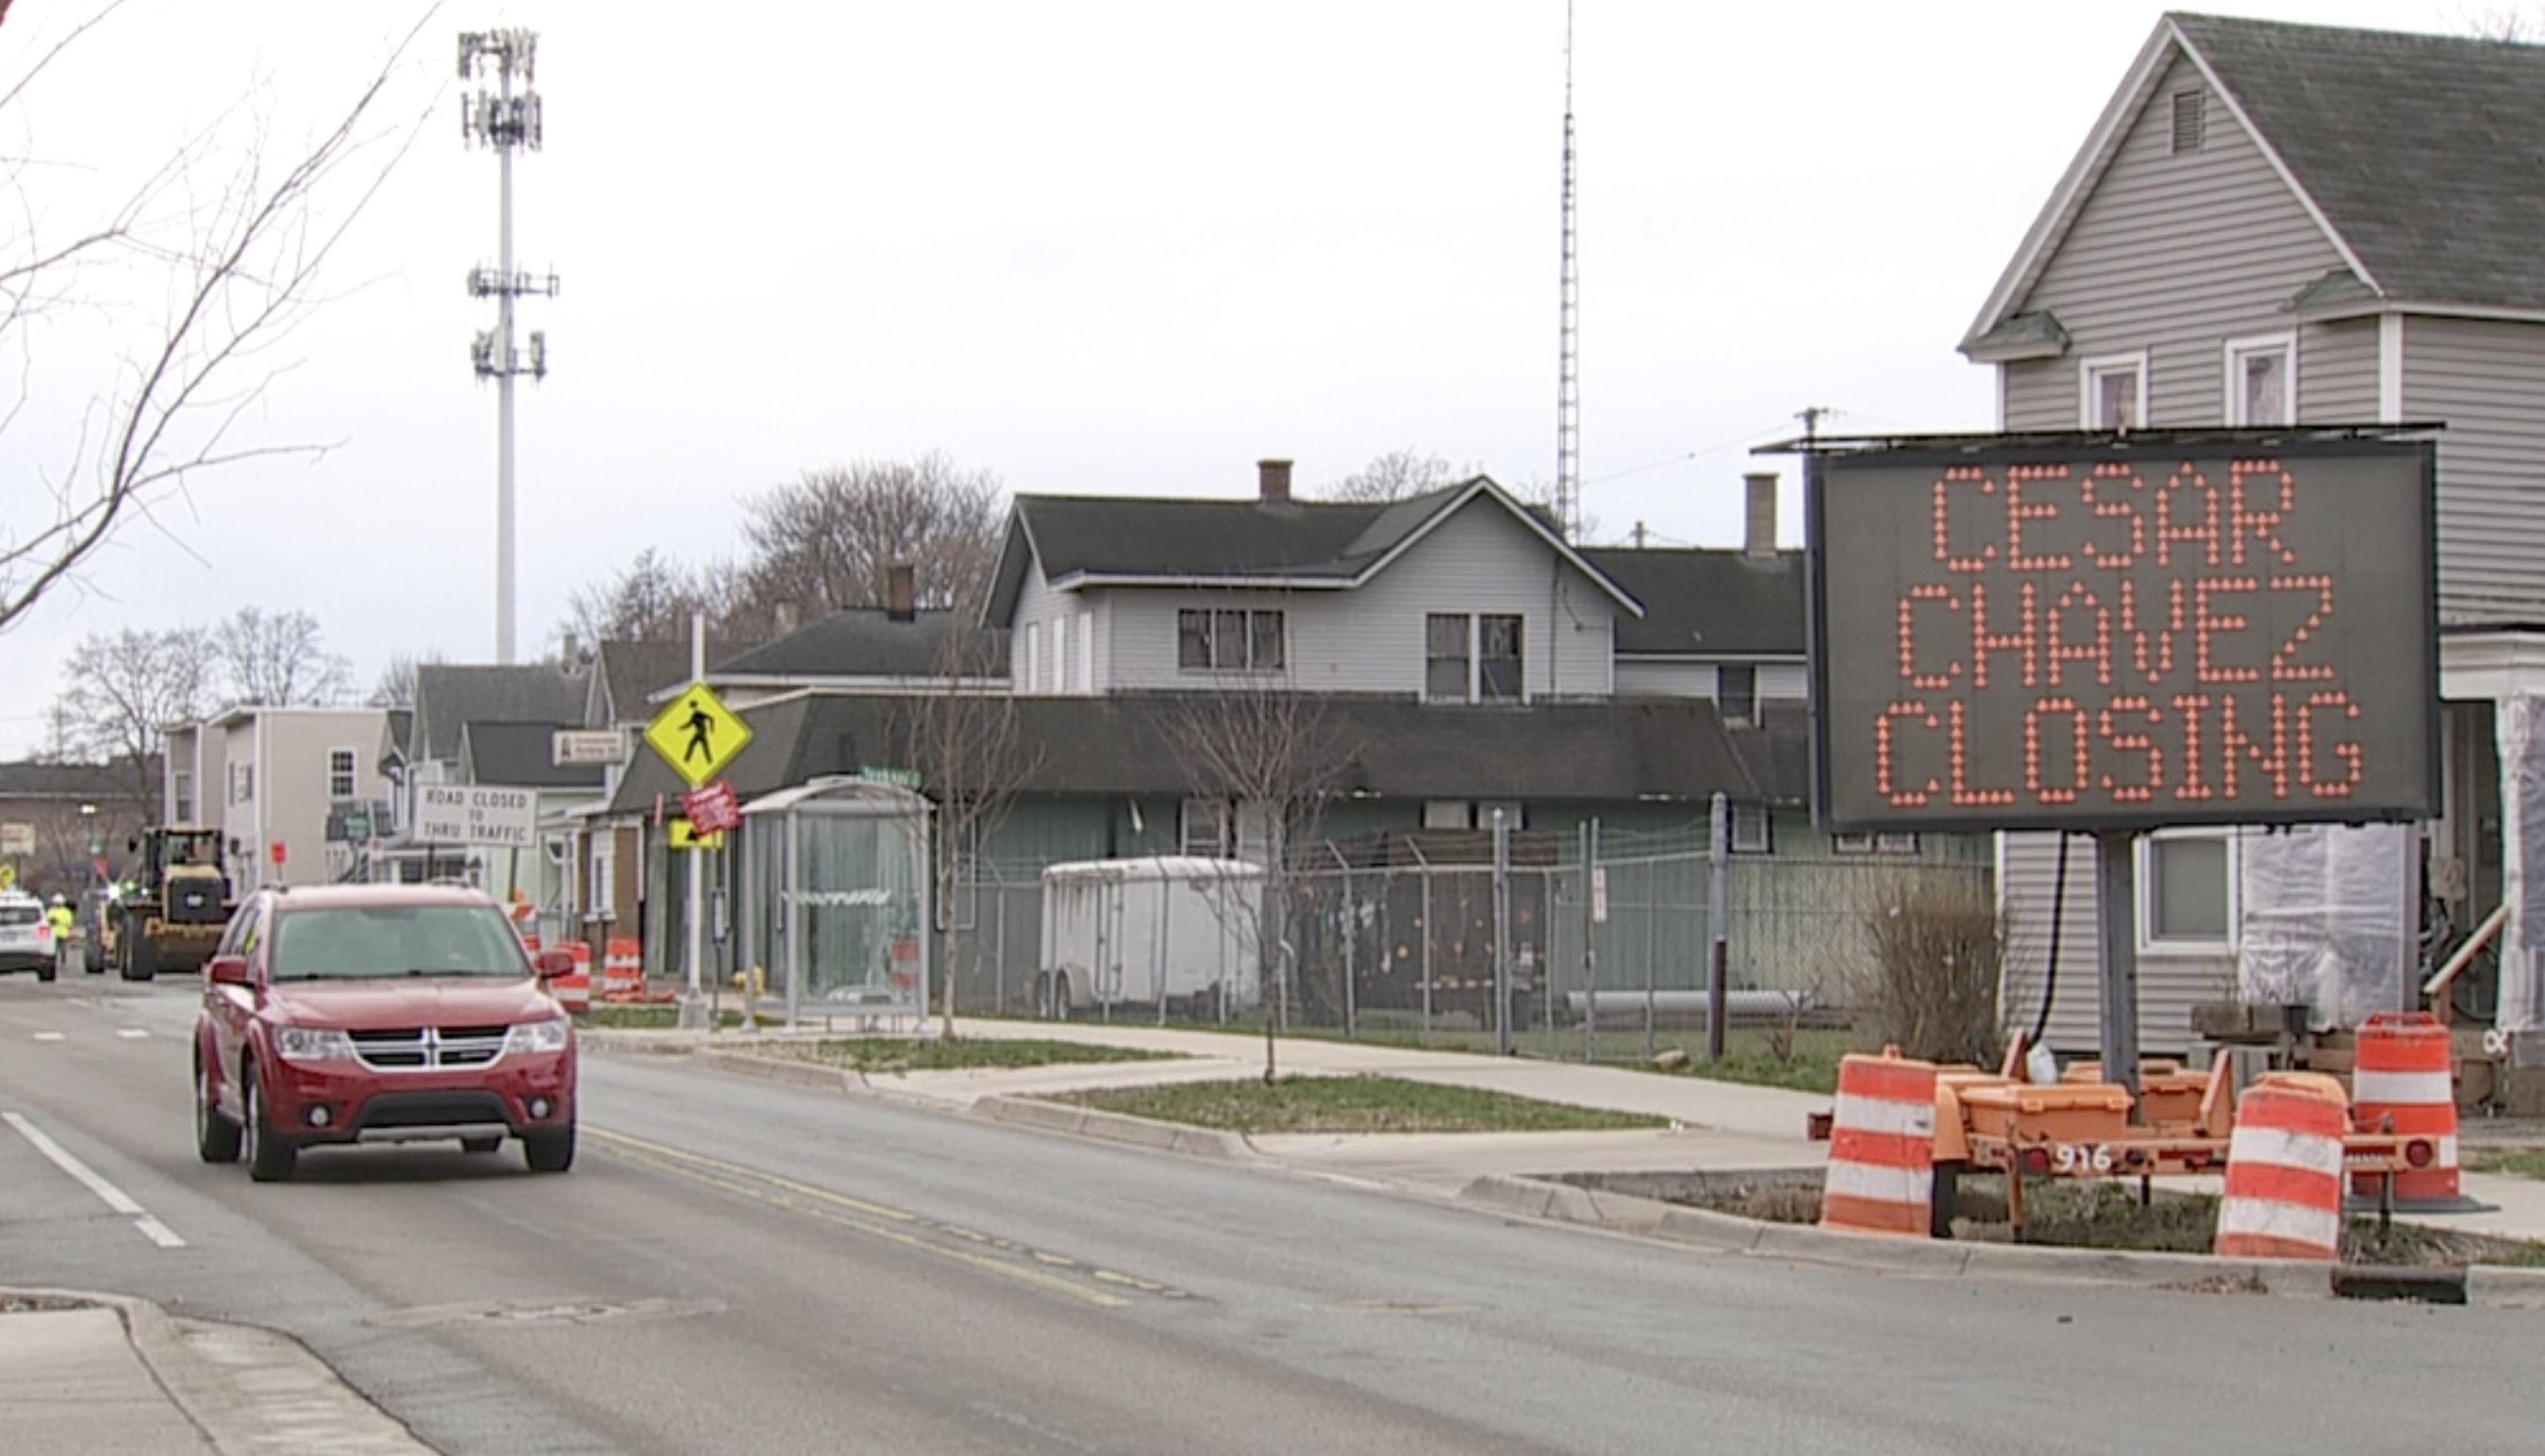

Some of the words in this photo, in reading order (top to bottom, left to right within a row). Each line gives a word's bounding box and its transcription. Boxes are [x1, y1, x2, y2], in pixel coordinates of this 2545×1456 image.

[1932, 460, 2295, 571] CESAR
[1898, 577, 2335, 689] CHAVEZ
[1876, 691, 2362, 806] CLOSING
[426, 789, 464, 806] ROAD
[473, 791, 527, 809] CLOSED
[469, 808, 484, 821] TO
[424, 822, 461, 837] THRU
[470, 824, 525, 841] TRAFFIC
[2056, 1143, 2112, 1172] 916
